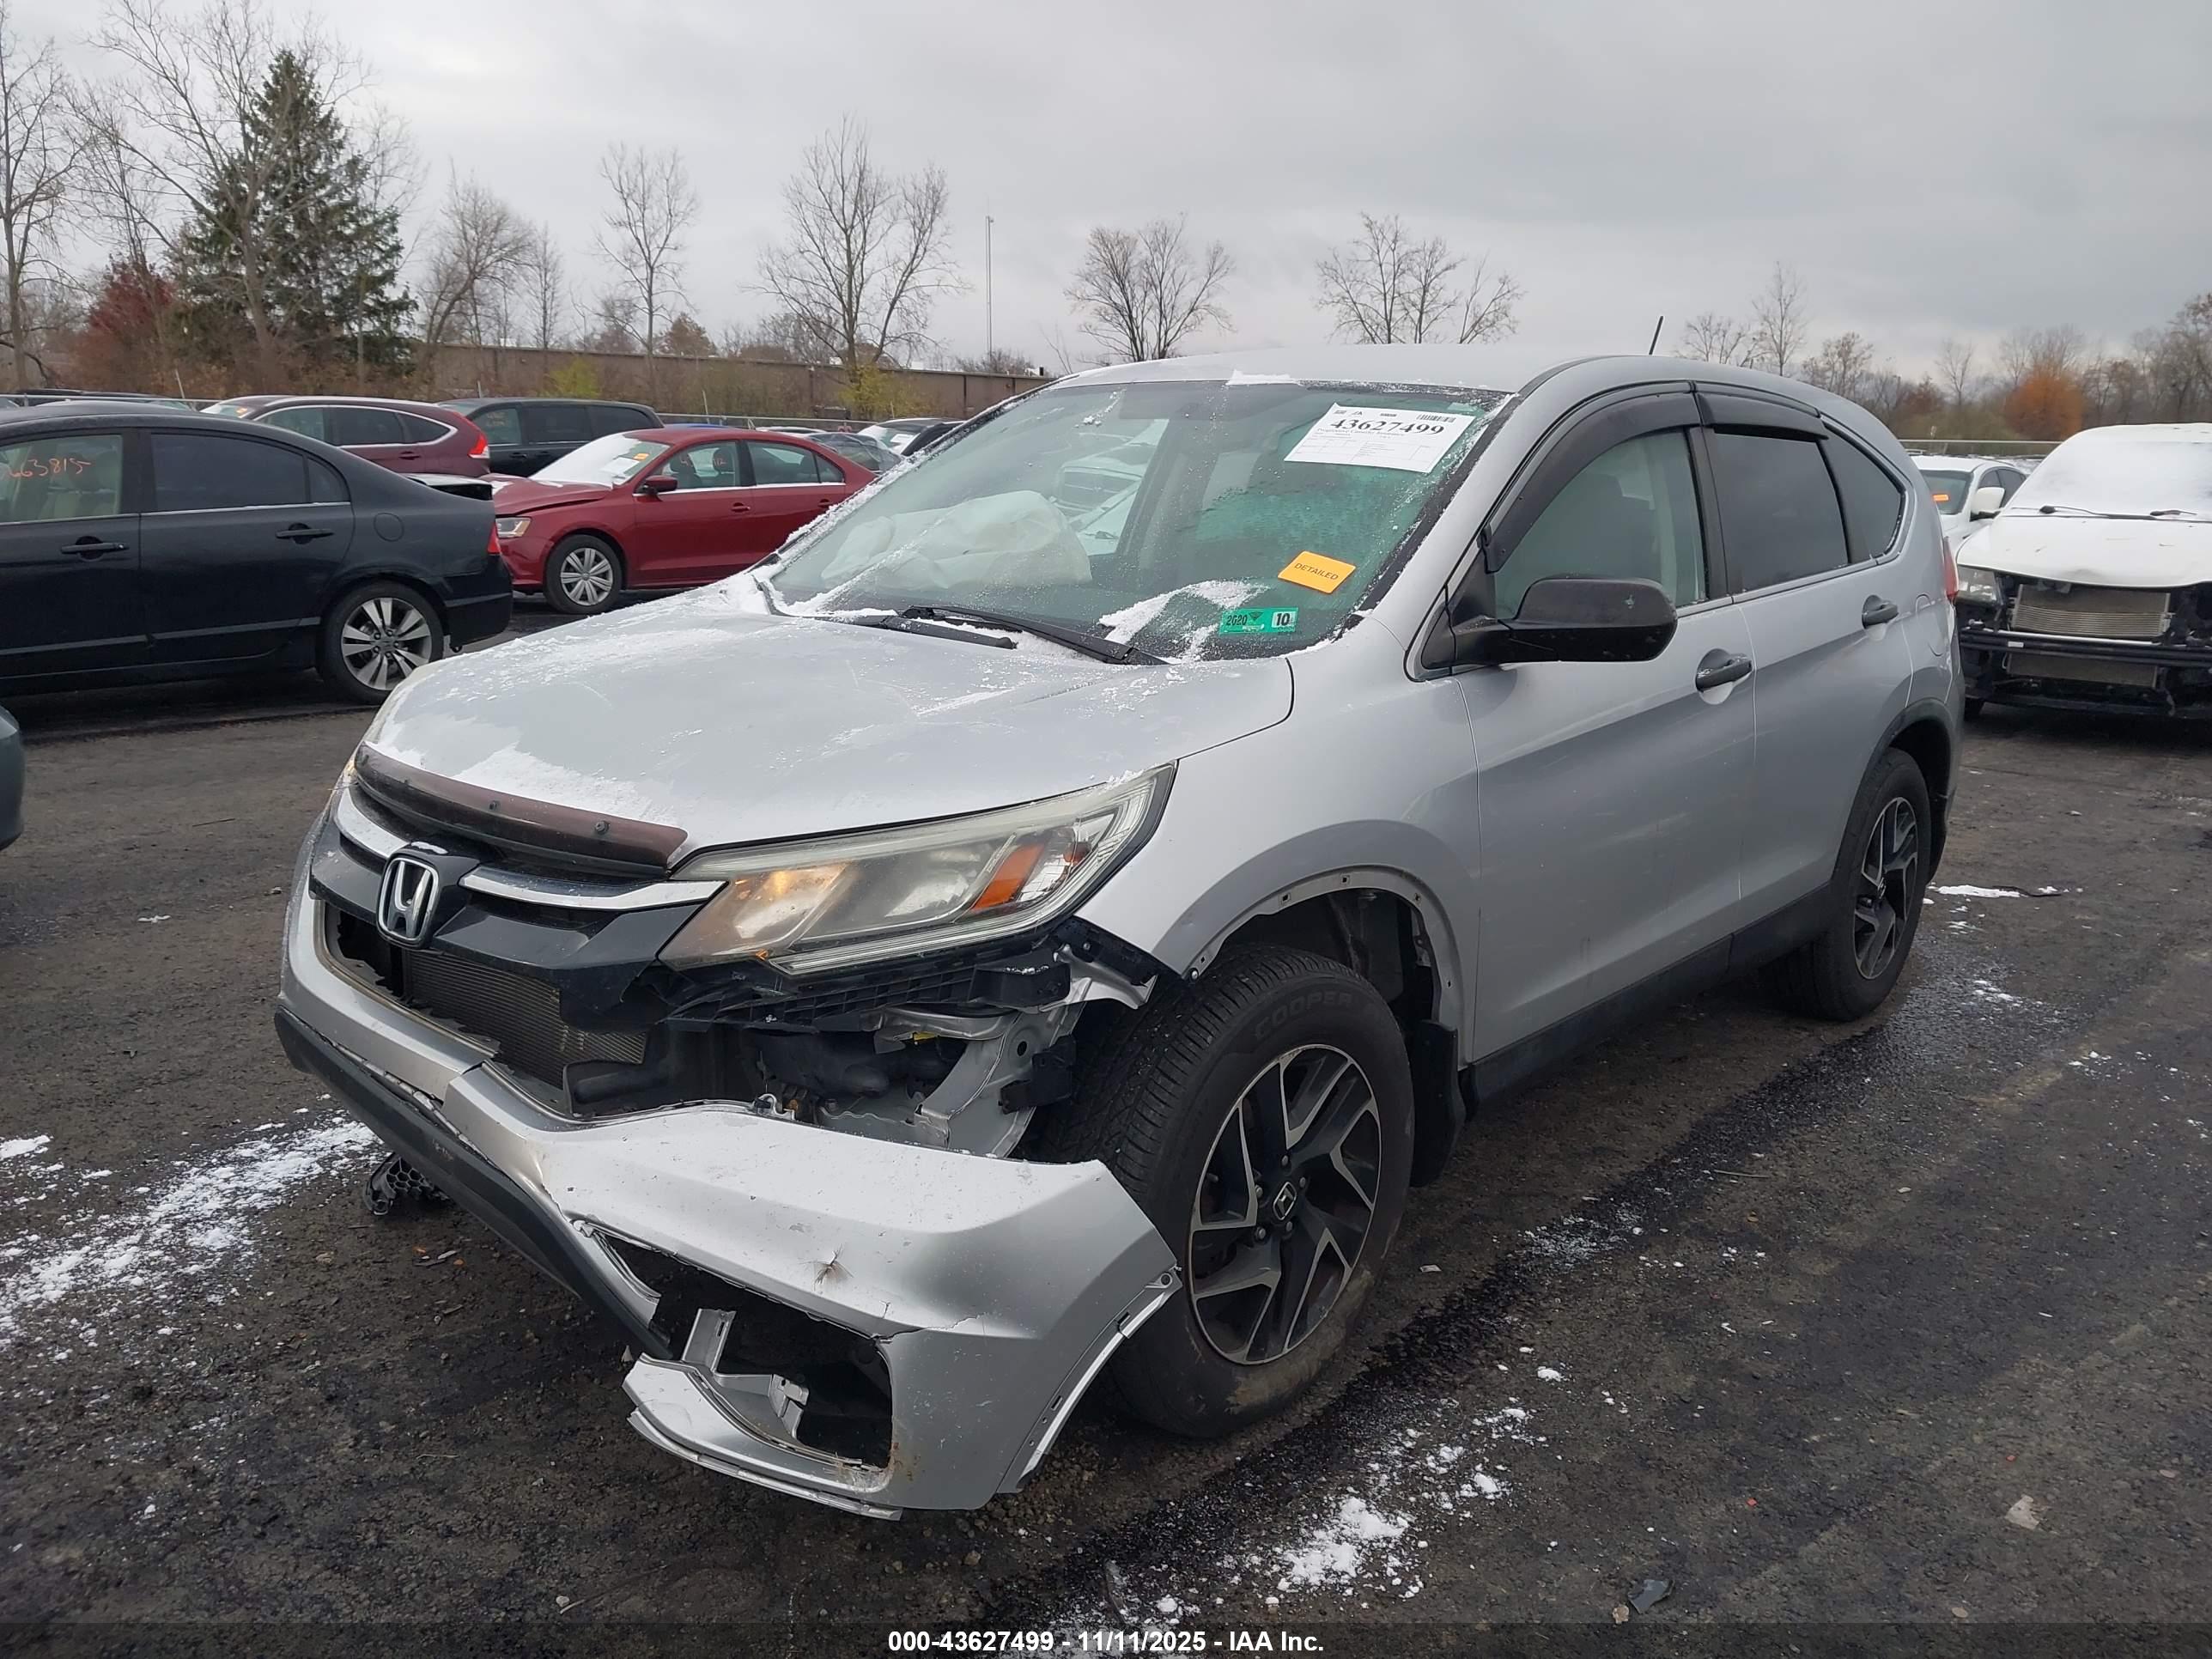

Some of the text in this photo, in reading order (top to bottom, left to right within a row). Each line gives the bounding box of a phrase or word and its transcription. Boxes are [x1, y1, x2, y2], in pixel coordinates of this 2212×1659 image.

[1330, 418, 1445, 435] 43627499
[1294, 562, 1339, 580] DETAILED
[1225, 614, 1248, 626] 2020
[1276, 612, 1291, 626] 10
[1254, 991, 1352, 1040] COOPER
